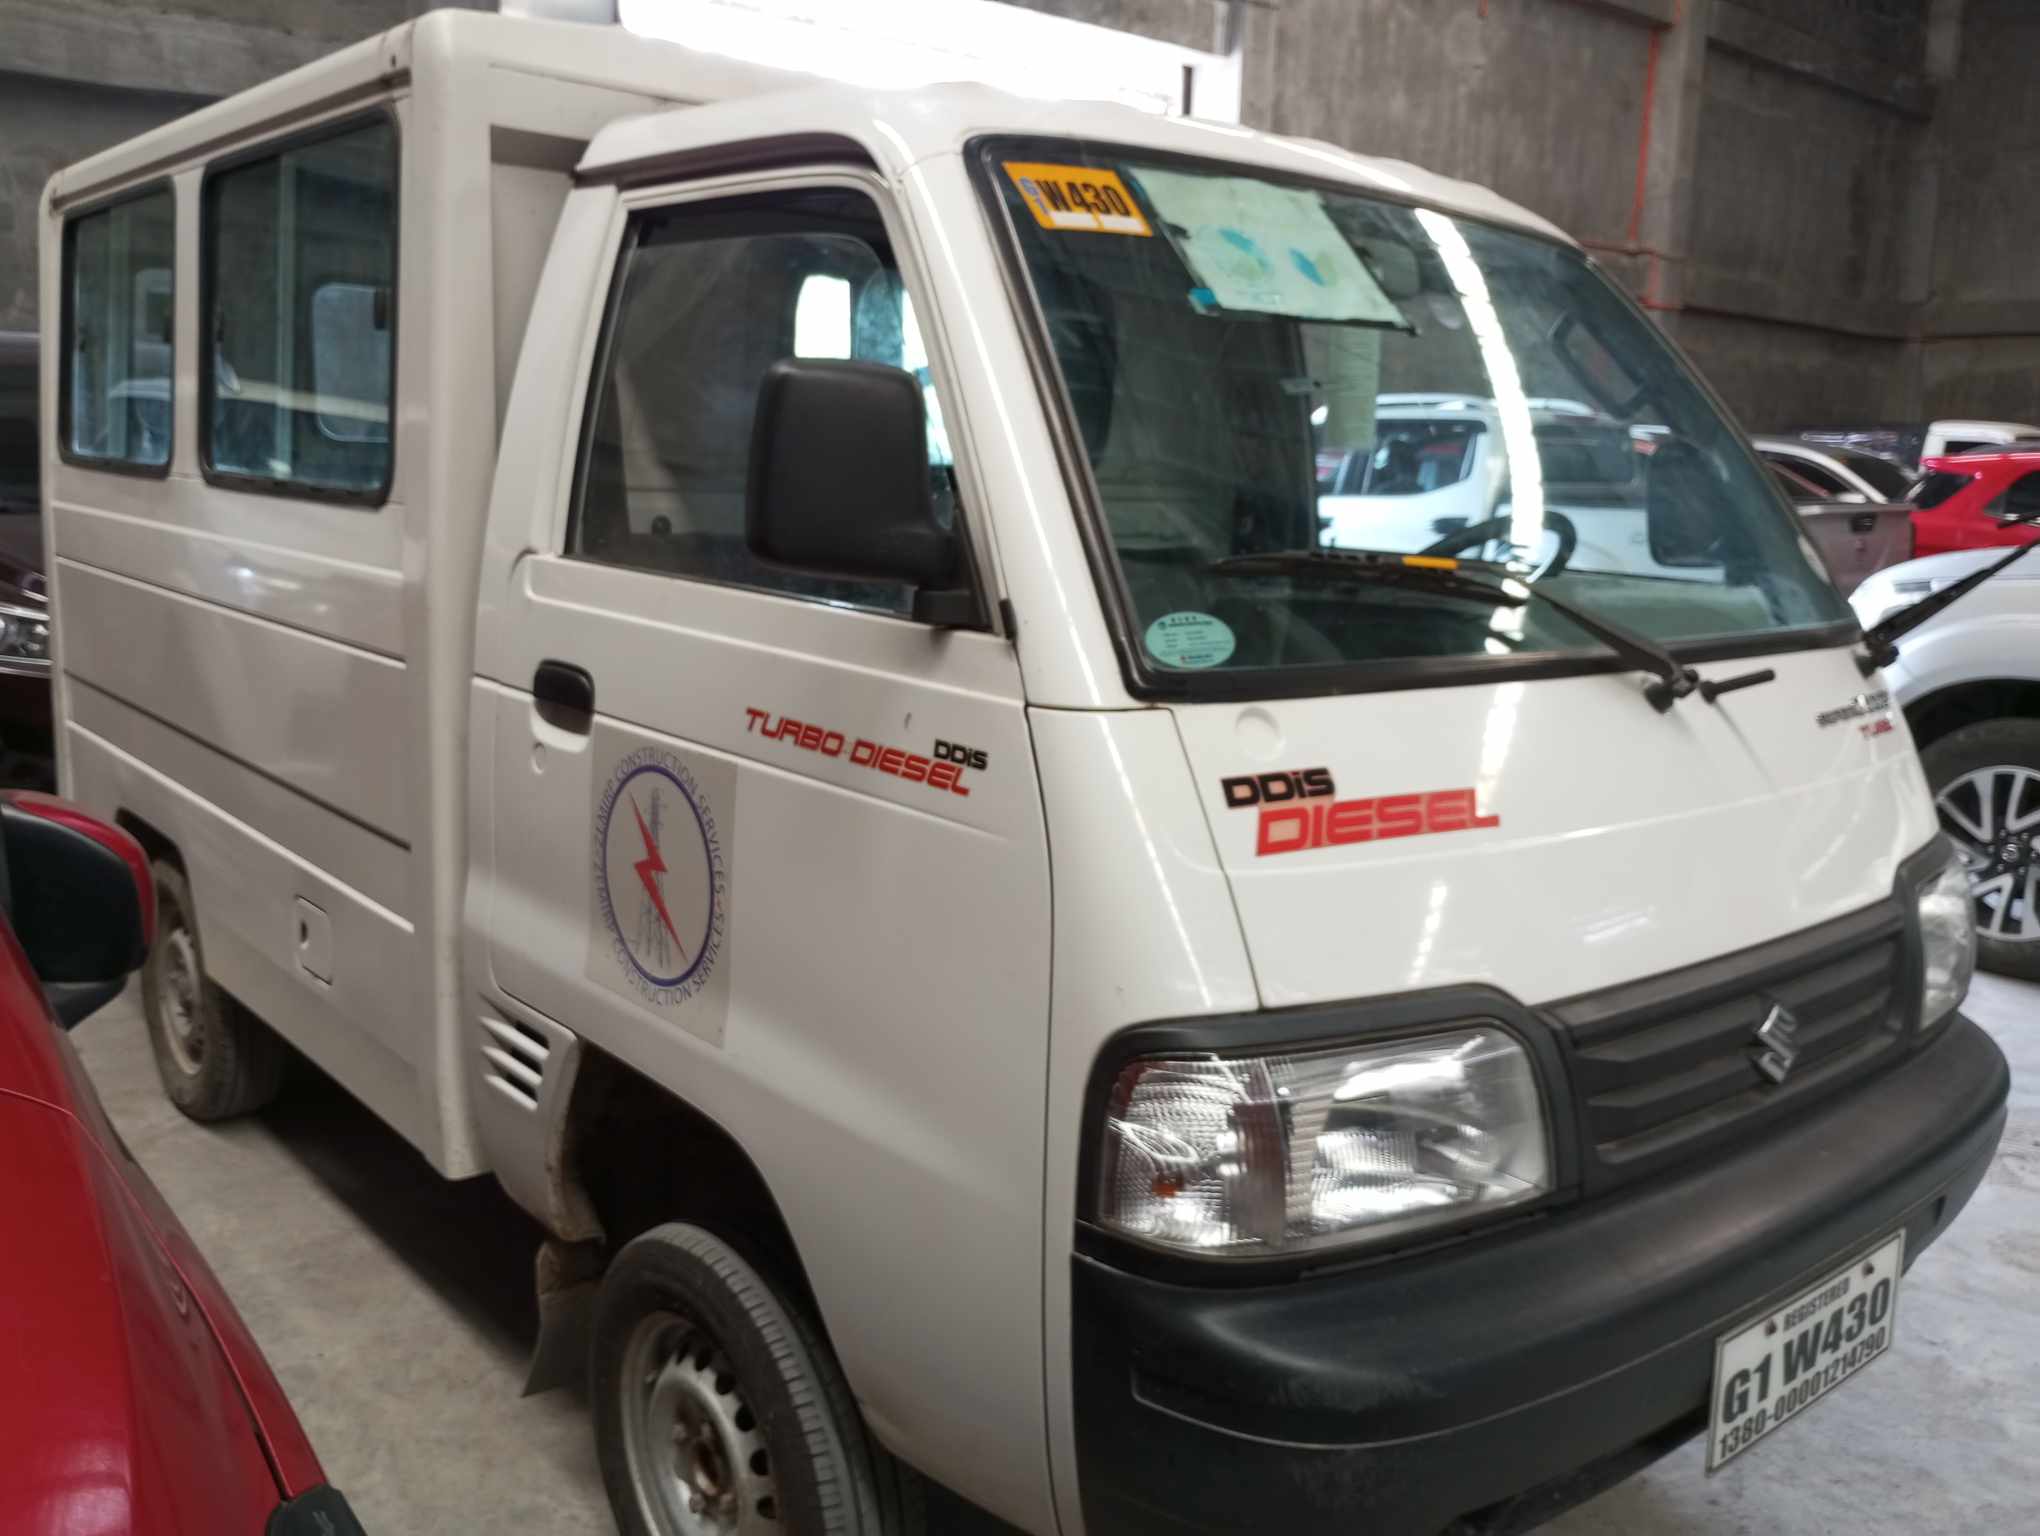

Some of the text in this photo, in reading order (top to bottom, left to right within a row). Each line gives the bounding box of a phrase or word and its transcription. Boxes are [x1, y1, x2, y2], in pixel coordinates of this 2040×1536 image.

[1034, 179, 1132, 218] W430
[746, 707, 970, 797] TURBO DIESEL
[616, 746, 698, 796] CONSTRUCTION
[699, 794, 725, 894] SERVICES
[1256, 788, 1500, 857] DIESEL
[1722, 1277, 1891, 1424] G1 W430
